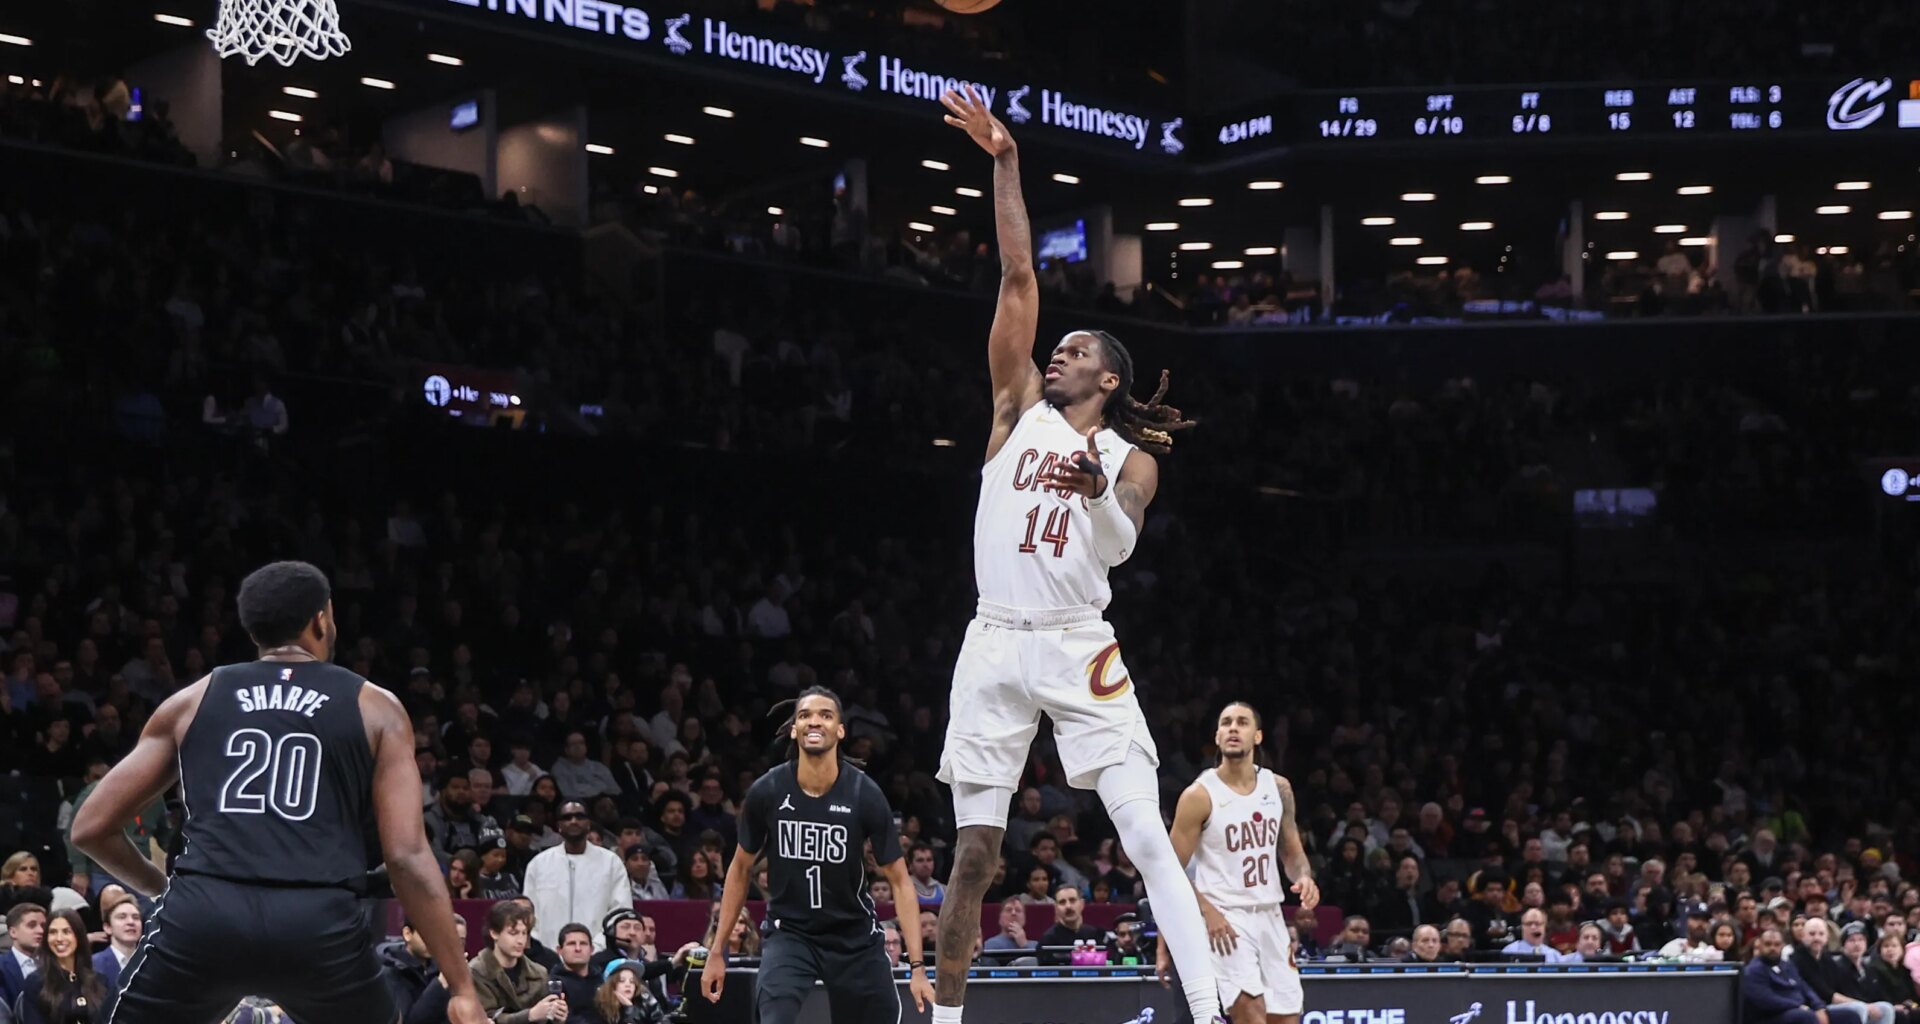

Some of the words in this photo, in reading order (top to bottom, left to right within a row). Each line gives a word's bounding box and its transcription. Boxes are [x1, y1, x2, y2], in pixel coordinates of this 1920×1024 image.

[544, 0, 650, 40] NETS
[704, 18, 830, 84] Hennessy
[1521, 92, 1540, 109] FT
[1769, 85, 1782, 103] 3
[1041, 89, 1150, 150] Hennessy
[1249, 115, 1272, 138] PM
[1608, 112, 1631, 130] 15
[1672, 110, 1695, 128] 12
[1769, 110, 1782, 128] 6
[1018, 504, 1071, 558] 14
[236, 683, 331, 719] SHARPE
[219, 728, 323, 821] 20
[778, 819, 848, 864] NETS
[1225, 817, 1278, 853] CAVS
[805, 865, 822, 909] 1
[1242, 853, 1270, 888] 20
